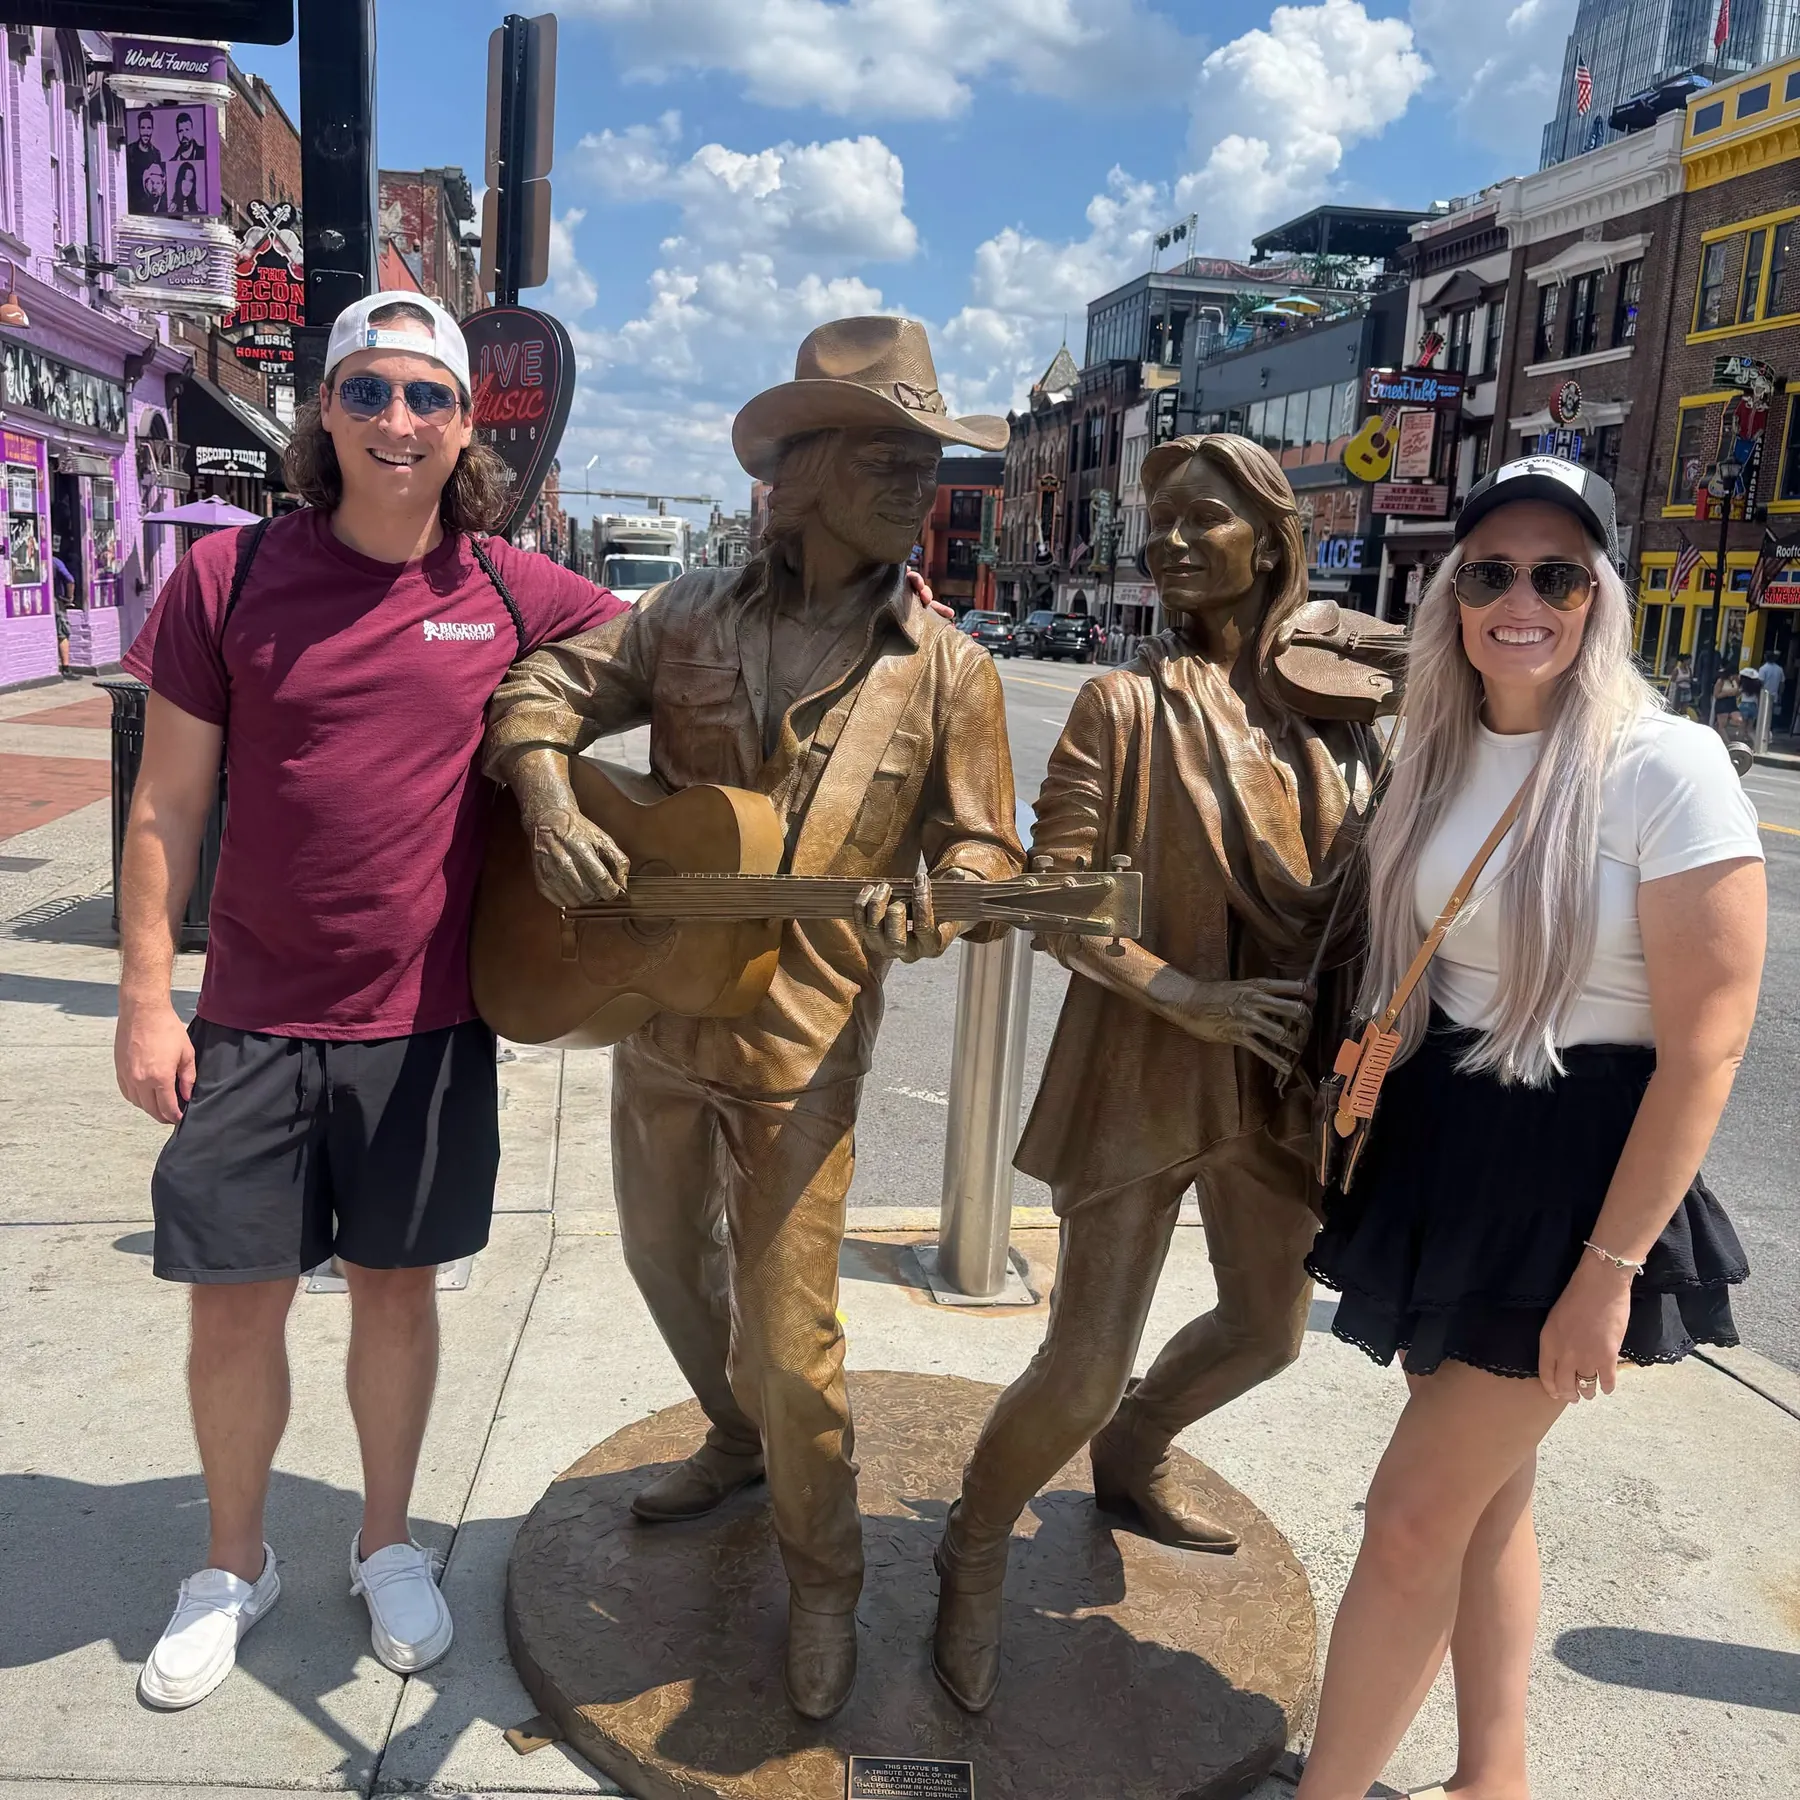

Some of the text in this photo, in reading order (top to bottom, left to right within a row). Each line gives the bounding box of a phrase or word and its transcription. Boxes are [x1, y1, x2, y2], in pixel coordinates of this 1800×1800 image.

[124, 48, 210, 73] World Famous
[257, 267, 288, 282] THE
[236, 280, 305, 306] ECON
[223, 302, 305, 329] FIDDL
[254, 334, 293, 349] MUSIC
[236, 346, 295, 361] HONKY TO
[259, 360, 288, 373] CITY
[480, 339, 545, 389] IVE
[1369, 373, 1437, 402] Ernest Tubb
[196, 446, 267, 472] SECOND FIDDLE
[439, 622, 496, 633] BIGFOOT
[870, 1775, 901, 1783] GREAT
[903, 1778, 953, 1786] MUSICIANS
[862, 1789, 923, 1797] ENTERTAINMENT
